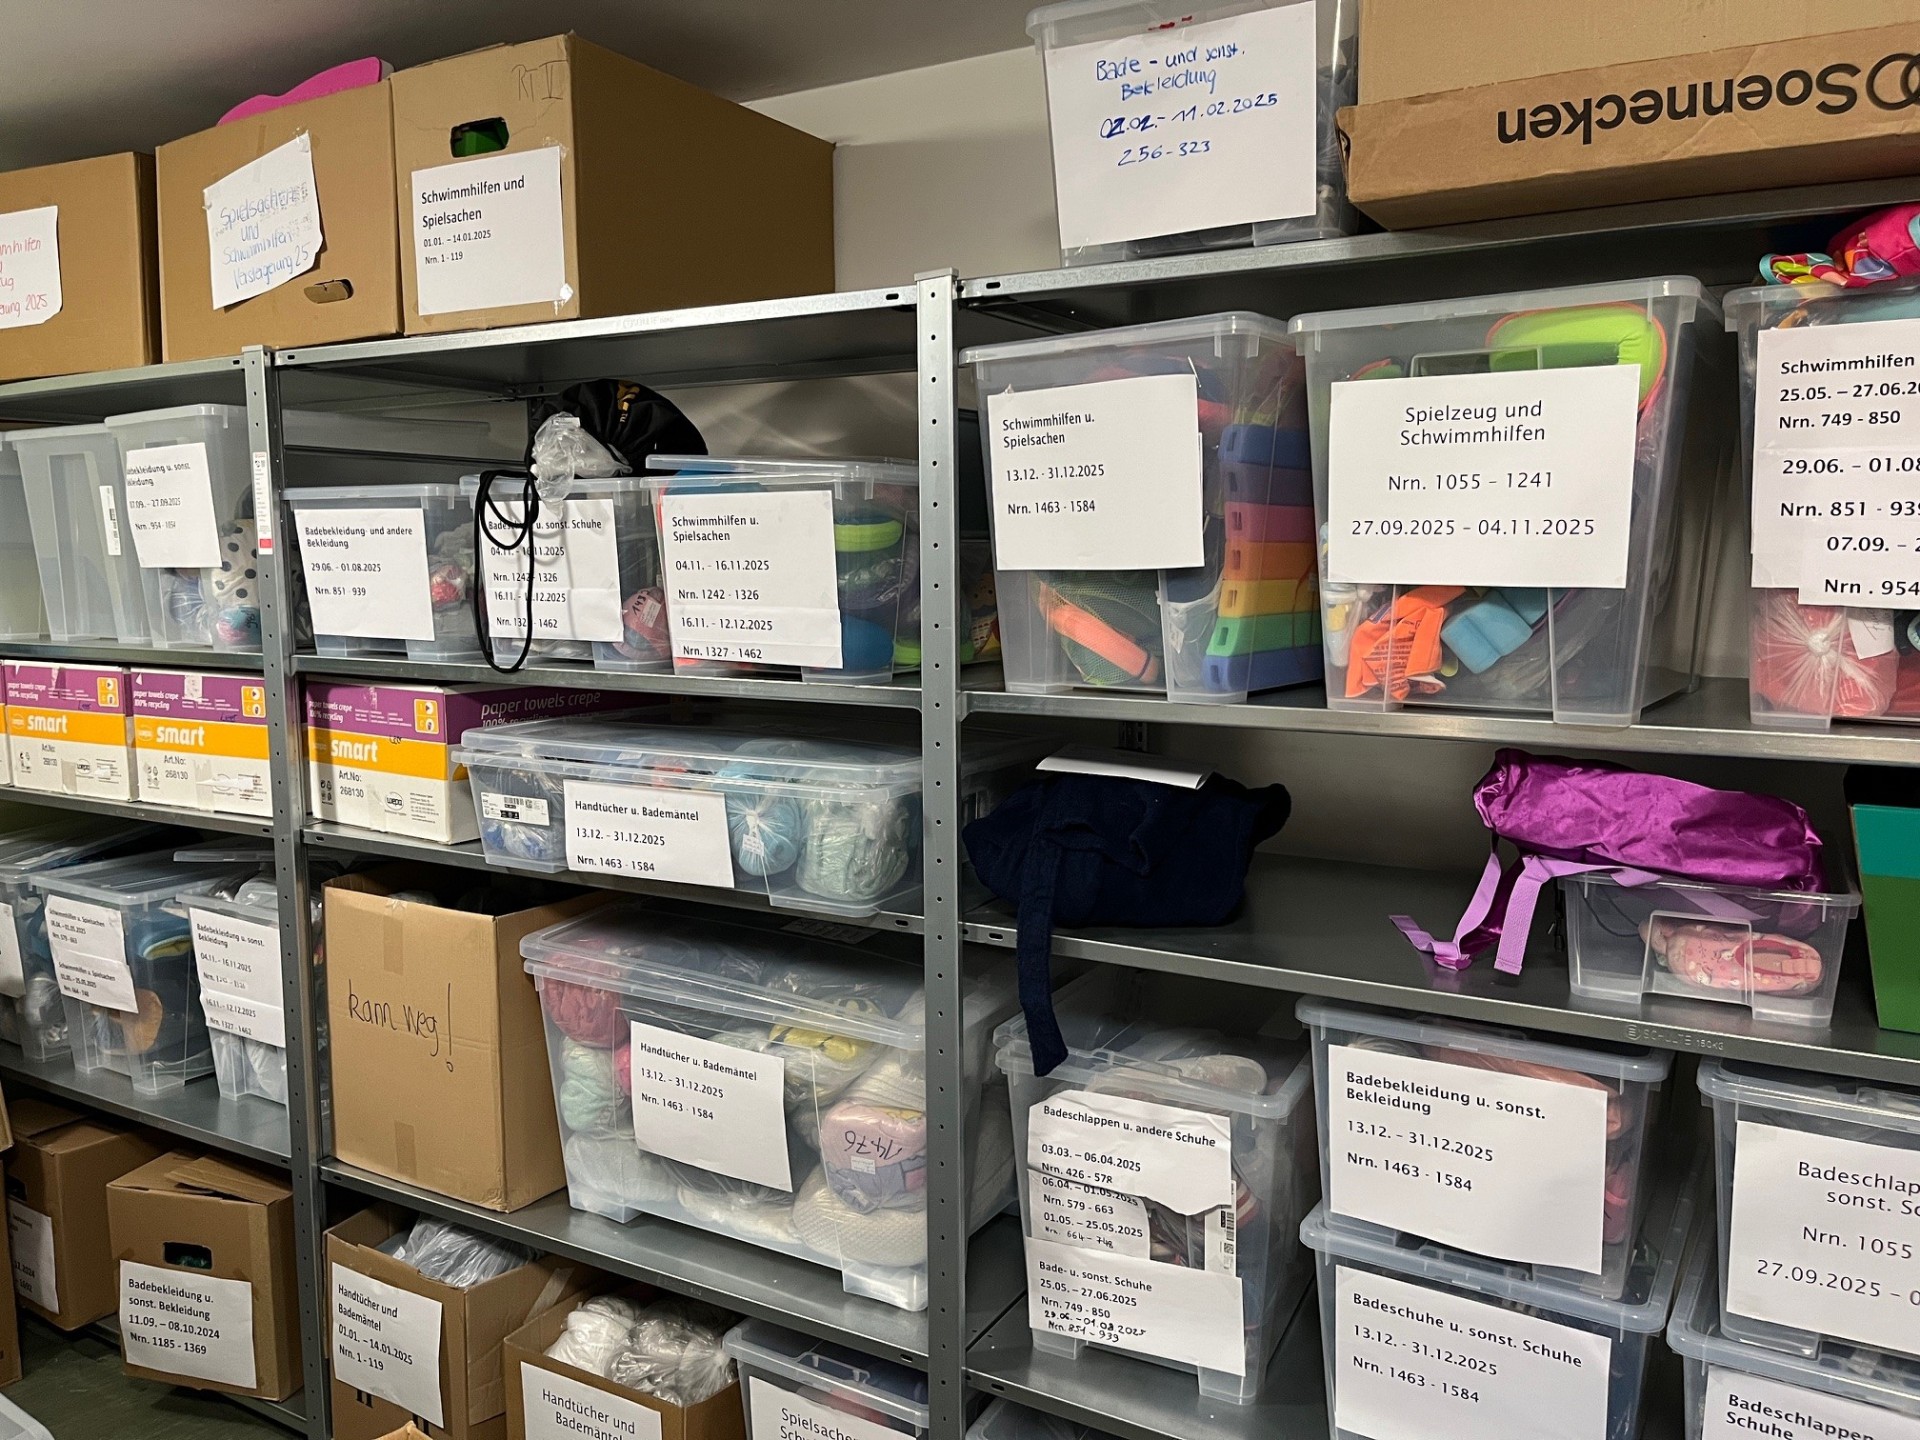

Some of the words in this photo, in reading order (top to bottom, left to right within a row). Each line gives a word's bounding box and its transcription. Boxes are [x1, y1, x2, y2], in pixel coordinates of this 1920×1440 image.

[1096, 58, 1142, 81] Bade
[1166, 47, 1198, 68] und
[1121, 69, 1217, 101] Bekleidung
[1498, 63, 1861, 145] Soennecken
[421, 181, 501, 204] Schwimmhilfen
[503, 175, 525, 191] und
[422, 209, 482, 230] Spielsachen
[453, 230, 492, 244] 14.01.2025
[1781, 354, 1915, 376] Schwimmhilfen
[1780, 387, 1832, 402] 25.05.
[1003, 412, 1082, 432] Schwimmhilfen
[1405, 404, 1498, 426] Spielzeug
[1505, 400, 1543, 418] und
[1821, 408, 1852, 427] 749
[1869, 411, 1901, 426] 850
[1003, 433, 1066, 450] Spielsachen
[1400, 424, 1546, 447] Schwimmhilfen
[1007, 469, 1039, 481] 13.12.
[1048, 464, 1105, 480] 31.12.2025
[1782, 462, 1844, 475] 29.06.
[1388, 475, 1427, 491] Nrn.
[1436, 473, 1481, 490] 1055
[1507, 472, 1553, 488] 1241
[1035, 502, 1061, 514] 1463
[1070, 500, 1096, 513] 1584
[1830, 502, 1867, 517] 851
[370, 526, 384, 536] und
[387, 526, 413, 536] andere
[547, 520, 570, 530] sonst.
[572, 518, 602, 531] Schuhe
[672, 515, 747, 528] Schwimmhilfen
[1352, 520, 1455, 537] 27.09.2025
[1478, 519, 1595, 537] 04.11.2025
[307, 539, 349, 550] Bekleidung
[673, 531, 731, 543] Spielsachen
[1827, 536, 1889, 552] 07.09.
[311, 562, 333, 571] 29.06.
[341, 563, 382, 573] 01.08.2025
[675, 560, 704, 571] 04.11.
[715, 560, 770, 571] 16.11.2025
[539, 574, 558, 583] 1326
[702, 590, 726, 601] 1242
[735, 590, 760, 601] 1326
[539, 619, 558, 629] 1462
[681, 617, 709, 629] 16.11.
[719, 619, 773, 631] 12.12.2025
[706, 647, 728, 658] 1327
[739, 648, 763, 660] 1462
[481, 700, 521, 720] paper
[524, 693, 565, 711] towels
[27, 715, 69, 735] smart
[156, 726, 205, 747] smart
[331, 740, 378, 763] smart
[340, 785, 365, 798] 268130
[575, 801, 628, 815] Handtücher
[643, 807, 699, 822] Bademäntel
[577, 827, 604, 840] 13.12.
[614, 832, 666, 846] 31.12.2025
[600, 857, 622, 869] 1463
[632, 861, 656, 873] 1584
[197, 923, 239, 943] Badebekleidung
[198, 933, 229, 949] Bekleidung
[349, 978, 398, 1031] kann
[641, 1042, 690, 1063] Handtücher
[703, 1060, 757, 1081] Bademäntel
[642, 1068, 667, 1083] 13.12.
[676, 1077, 724, 1099] 31.12.2025
[1346, 1071, 1470, 1107] Badebekleidung
[1496, 1100, 1547, 1121] sonst.
[1346, 1088, 1432, 1116] Bekleidung
[663, 1098, 684, 1112] 1463
[693, 1106, 714, 1121] 1584
[1043, 1105, 1120, 1131] Badeschlappen
[1135, 1125, 1173, 1141] andere
[1175, 1132, 1216, 1149] Schuhe
[844, 1130, 903, 1161] 1476
[1348, 1119, 1392, 1140] 13.12.
[1409, 1132, 1494, 1162] 31.12.2025
[1041, 1143, 1073, 1159] 03.03.
[1084, 1151, 1142, 1173] 06.04.2025
[1066, 1167, 1085, 1180] 426
[1384, 1159, 1420, 1179] 1463
[1436, 1171, 1473, 1192] 1584
[1083, 1184, 1140, 1208] 01.05.2025
[1826, 1191, 1891, 1213] sonst.
[1067, 1199, 1087, 1212] 579
[1095, 1203, 1114, 1215] 663
[1044, 1212, 1074, 1227] 01.05.
[1085, 1219, 1143, 1238] 25.05.2025
[1803, 1226, 1847, 1247] Nrn.
[1859, 1235, 1912, 1260] 1055
[1039, 1260, 1067, 1277] Bade-
[1082, 1270, 1112, 1285] sonst.
[1115, 1276, 1153, 1293] Schuhe
[1757, 1259, 1881, 1297] 27.09.2025
[129, 1278, 202, 1304] Badebekleidung
[338, 1282, 380, 1312] Handtücher
[382, 1306, 398, 1319] und
[1041, 1278, 1070, 1294] 25.05.
[1081, 1287, 1137, 1307] 27.06.2025
[129, 1297, 156, 1310] sonst.
[159, 1301, 211, 1322] Bekleidung
[338, 1303, 381, 1332] Bademäntel
[1065, 1300, 1083, 1313] 749
[1092, 1305, 1111, 1319] 850
[129, 1314, 159, 1329] 11.09.
[168, 1320, 220, 1340] 08.10.2024
[1353, 1293, 1444, 1329] Badeschuhe
[1468, 1327, 1517, 1350] sonst.
[1522, 1339, 1583, 1369] Schuhe
[153, 1337, 176, 1350] 1185
[184, 1342, 207, 1355] 1369
[338, 1324, 360, 1343] 01.01.
[370, 1338, 413, 1365] 14.01.2025
[1353, 1325, 1398, 1349] 13.12.
[1411, 1341, 1498, 1377] 31.12.2025
[369, 1356, 384, 1371] 119
[1390, 1366, 1426, 1388] 1463
[1442, 1382, 1480, 1403] 1584
[542, 1388, 609, 1424] Handtücher
[614, 1417, 635, 1435] und
